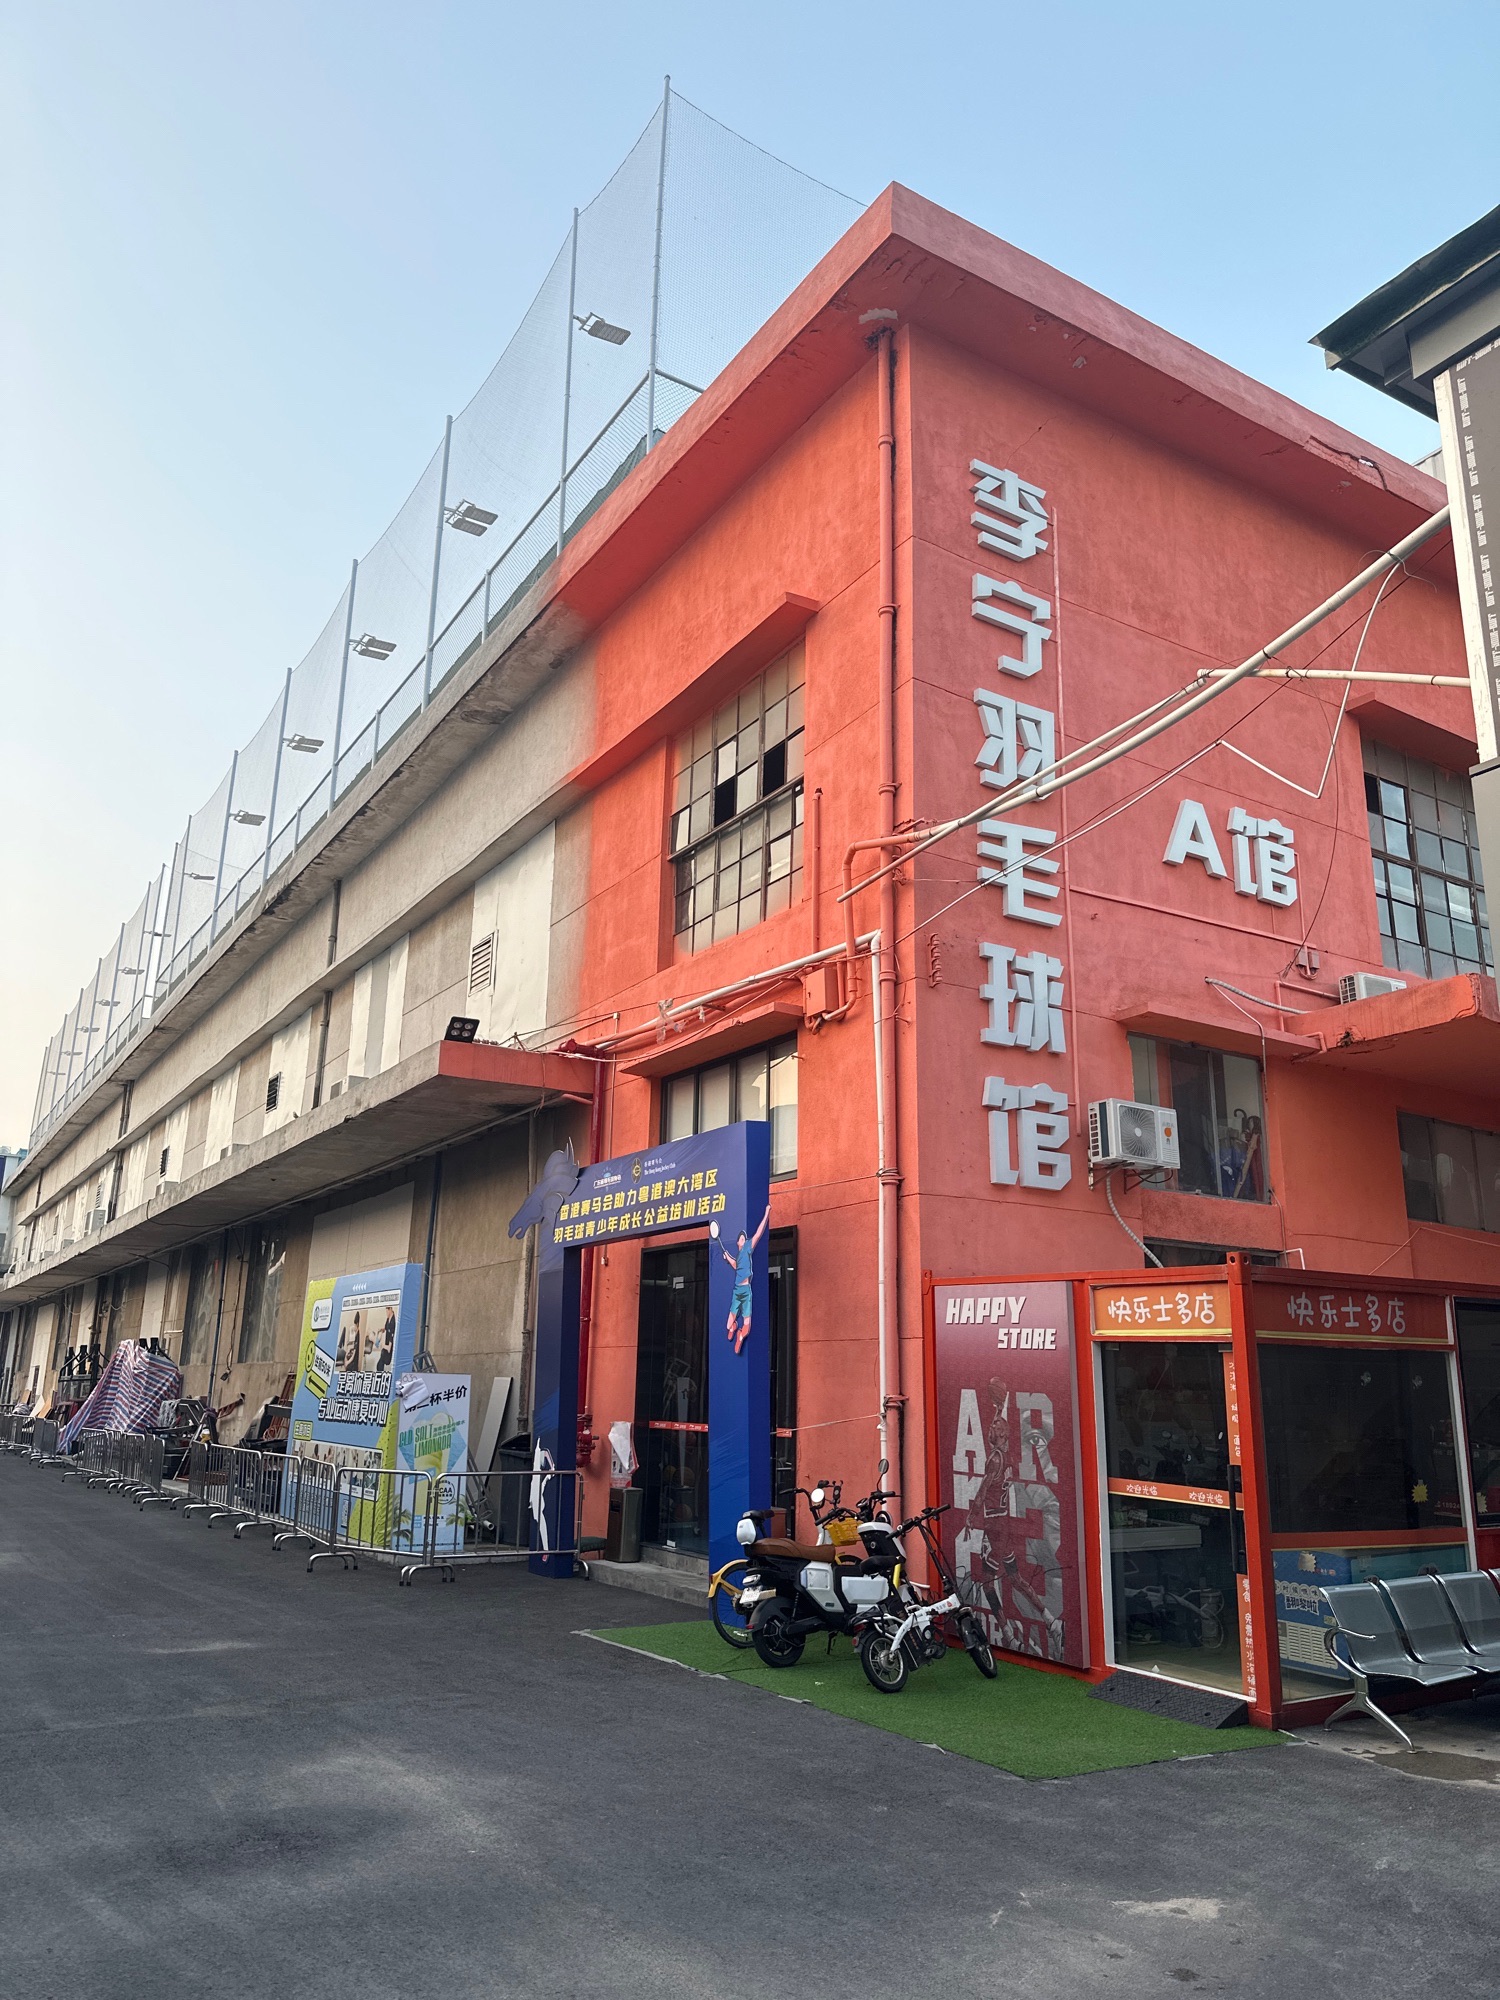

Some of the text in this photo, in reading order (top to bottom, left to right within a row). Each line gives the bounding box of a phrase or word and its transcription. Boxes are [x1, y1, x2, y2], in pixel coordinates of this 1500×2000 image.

[969, 458, 1072, 1191] 李宁羽毛球馆
[1162, 798, 1298, 908] A馆
[559, 1168, 718, 1221] 香港赛马会助力粤港澳大湾区
[553, 1193, 726, 1243] 羽毛球青少年成长公益培训活动
[945, 1296, 1027, 1324] HAPPY
[1107, 1292, 1214, 1325] 快乐士多店
[1287, 1291, 1406, 1334] 快乐士多店
[997, 1327, 1057, 1350] STORE
[336, 1371, 392, 1397] 是离你最近的
[405, 1385, 468, 1413] 杯半价
[318, 1397, 389, 1426] 专业运动康复中心
[953, 1388, 1058, 1484] AR
[1126, 1483, 1158, 1496] 欢迎光临
[1188, 1491, 1224, 1504] 欢迎光临
